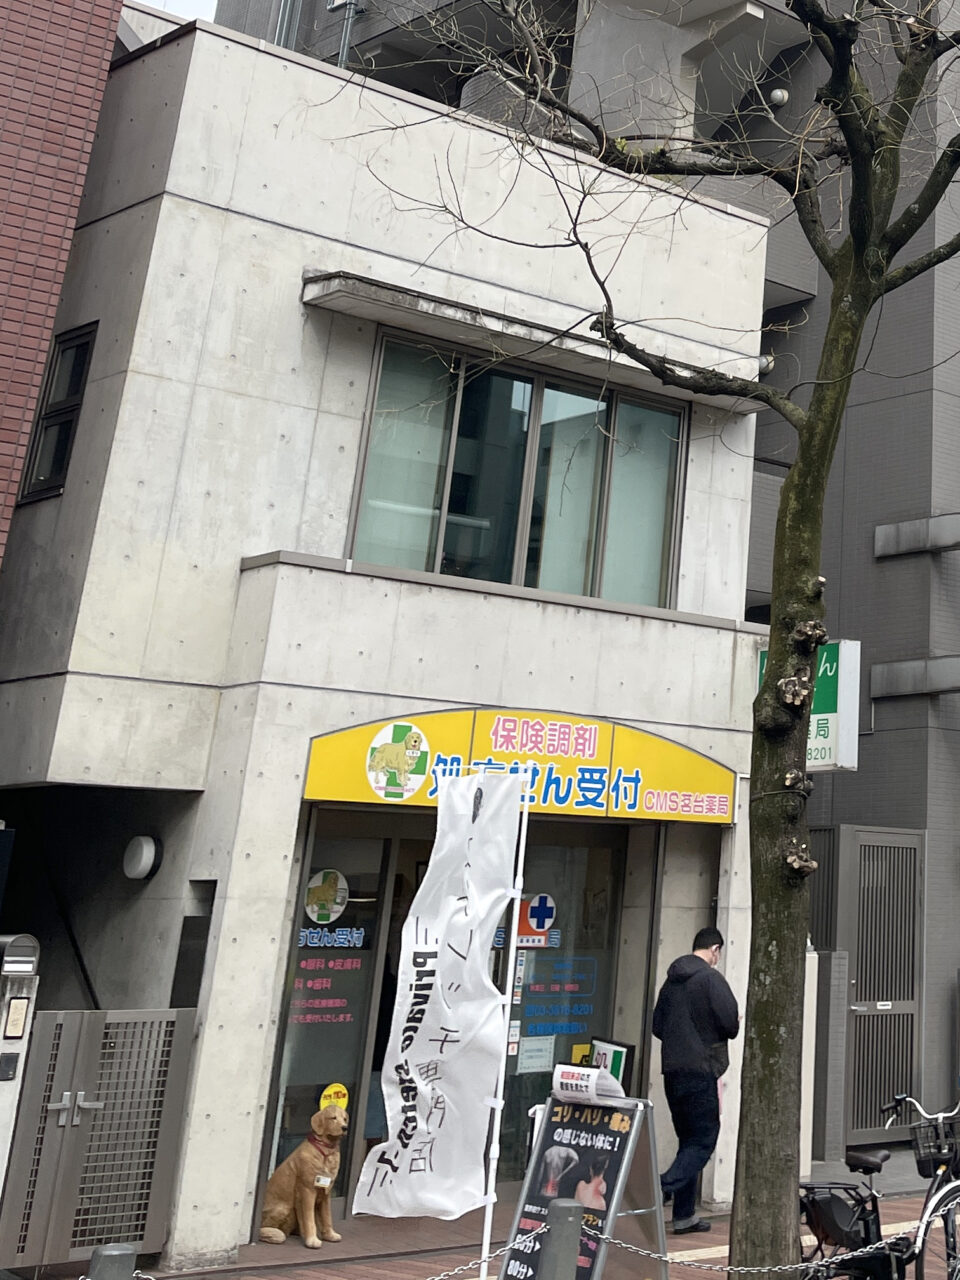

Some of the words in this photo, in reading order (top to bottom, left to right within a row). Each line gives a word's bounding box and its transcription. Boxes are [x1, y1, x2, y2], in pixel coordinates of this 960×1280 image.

[491, 717, 597, 759] 保険調剤
[644, 790, 729, 815] CMS茗台薬局
